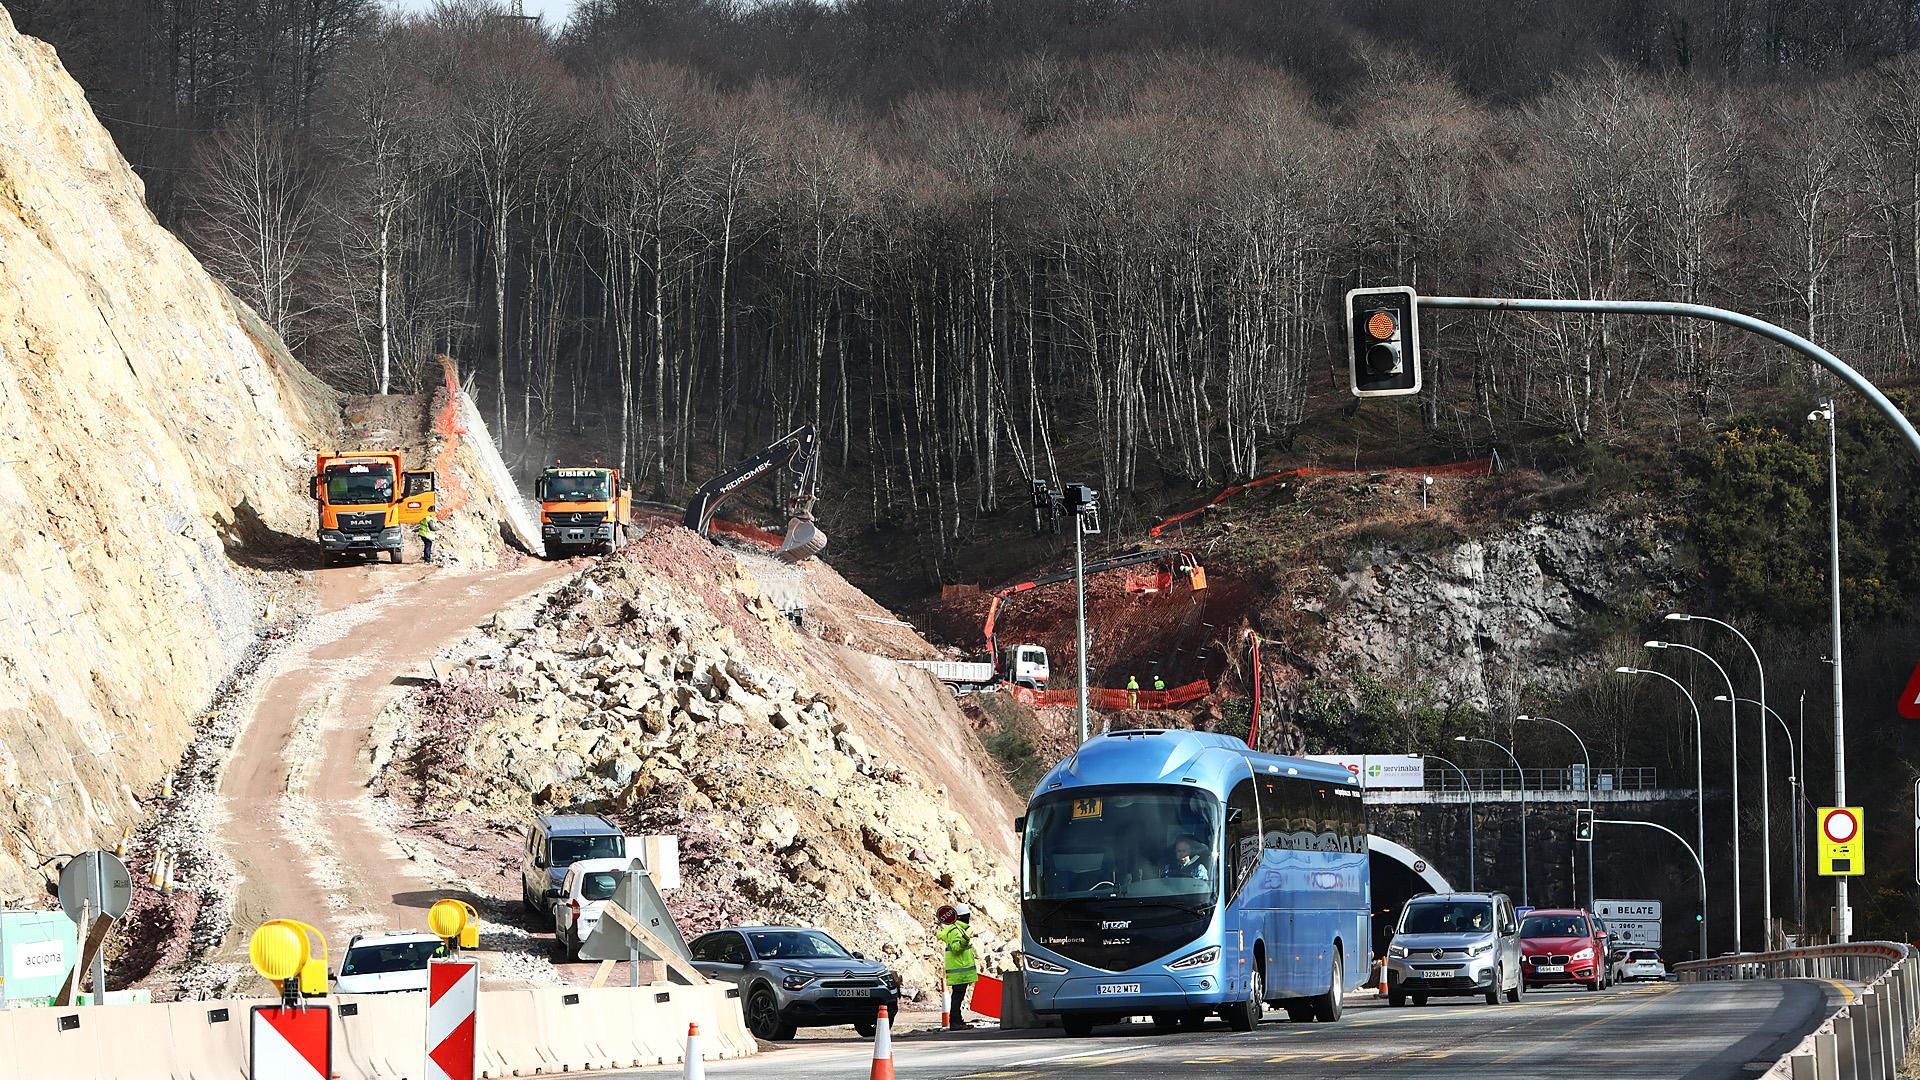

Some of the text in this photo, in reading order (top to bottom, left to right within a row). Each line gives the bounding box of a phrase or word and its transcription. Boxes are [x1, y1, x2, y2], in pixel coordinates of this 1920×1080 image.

[719, 459, 773, 493] HIDROMEK
[1383, 764, 1421, 772] servinabar
[940, 909, 956, 922] STOP
[1617, 906, 1654, 915] BELATE
[1040, 935, 1085, 945] La Pamplonesa
[25, 952, 62, 966] acciona
[1424, 970, 1440, 978] 3284
[1102, 984, 1139, 994] 2412 MTZ
